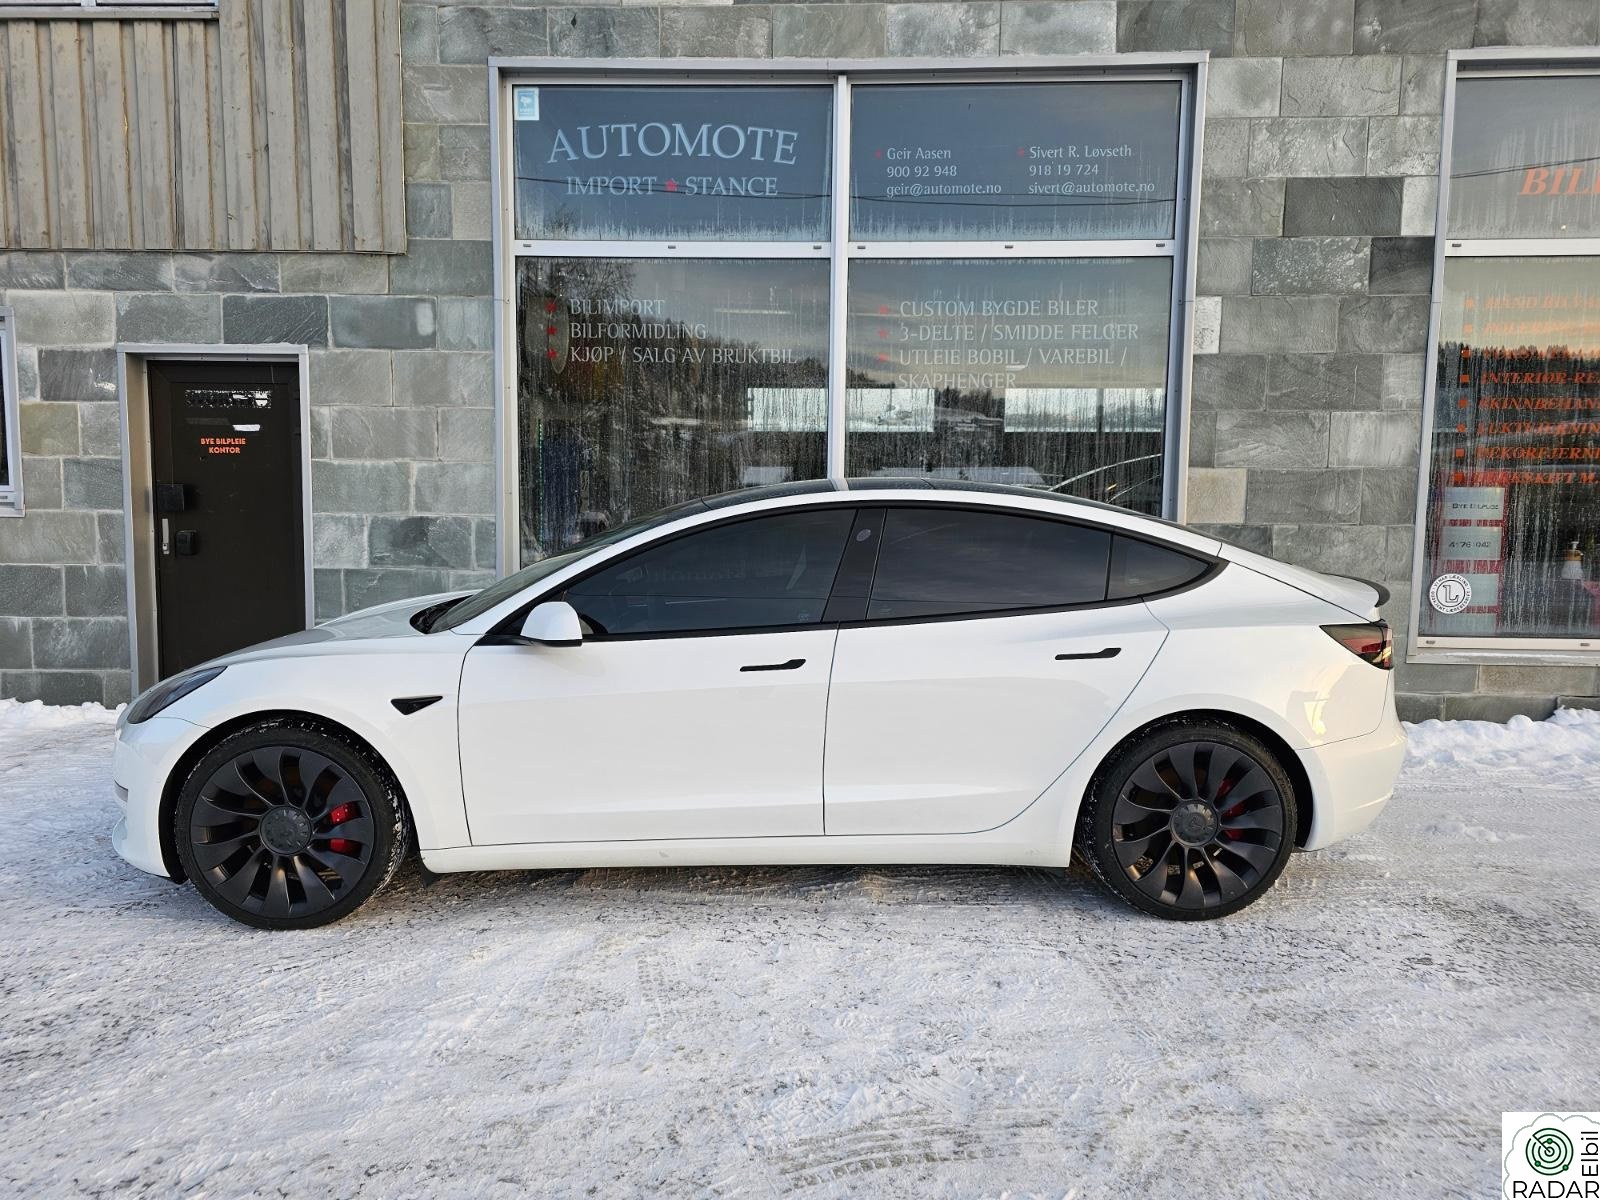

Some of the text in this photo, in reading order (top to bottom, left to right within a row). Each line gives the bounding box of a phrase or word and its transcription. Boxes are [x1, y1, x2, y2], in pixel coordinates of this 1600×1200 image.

[547, 122, 799, 165] AUTOMOTE
[887, 148, 951, 160] Geir Aasen
[1029, 145, 1132, 159] Sivert R. Løvseth
[887, 165, 957, 177] 900 92 948
[1029, 164, 1099, 176] 918 19 724
[566, 176, 778, 196] IMPORT STANCE
[1028, 181, 1155, 195] sivert@automote.no
[1519, 166, 1600, 196] BIL
[886, 183, 1002, 198] geir@automote.no
[570, 299, 665, 315] BILIMPORT
[900, 300, 1098, 317] CUSTOM BYGDE BILER
[570, 323, 707, 339] BILFORMIDLING
[900, 324, 974, 341] 3-DELTE
[994, 324, 1064, 341] SMIDDE
[1071, 324, 1139, 340] FELGER
[570, 347, 614, 363] KJØP
[632, 347, 676, 363] SALG
[682, 348, 705, 364] AV
[712, 348, 798, 364] BRUKTBIL
[899, 349, 960, 366] UTLEIE
[968, 349, 1021, 365] BOBIL
[1038, 348, 1114, 365] VAREBIL
[898, 373, 1017, 389] SKAPHENGER
[208, 446, 241, 454] KONTOR
